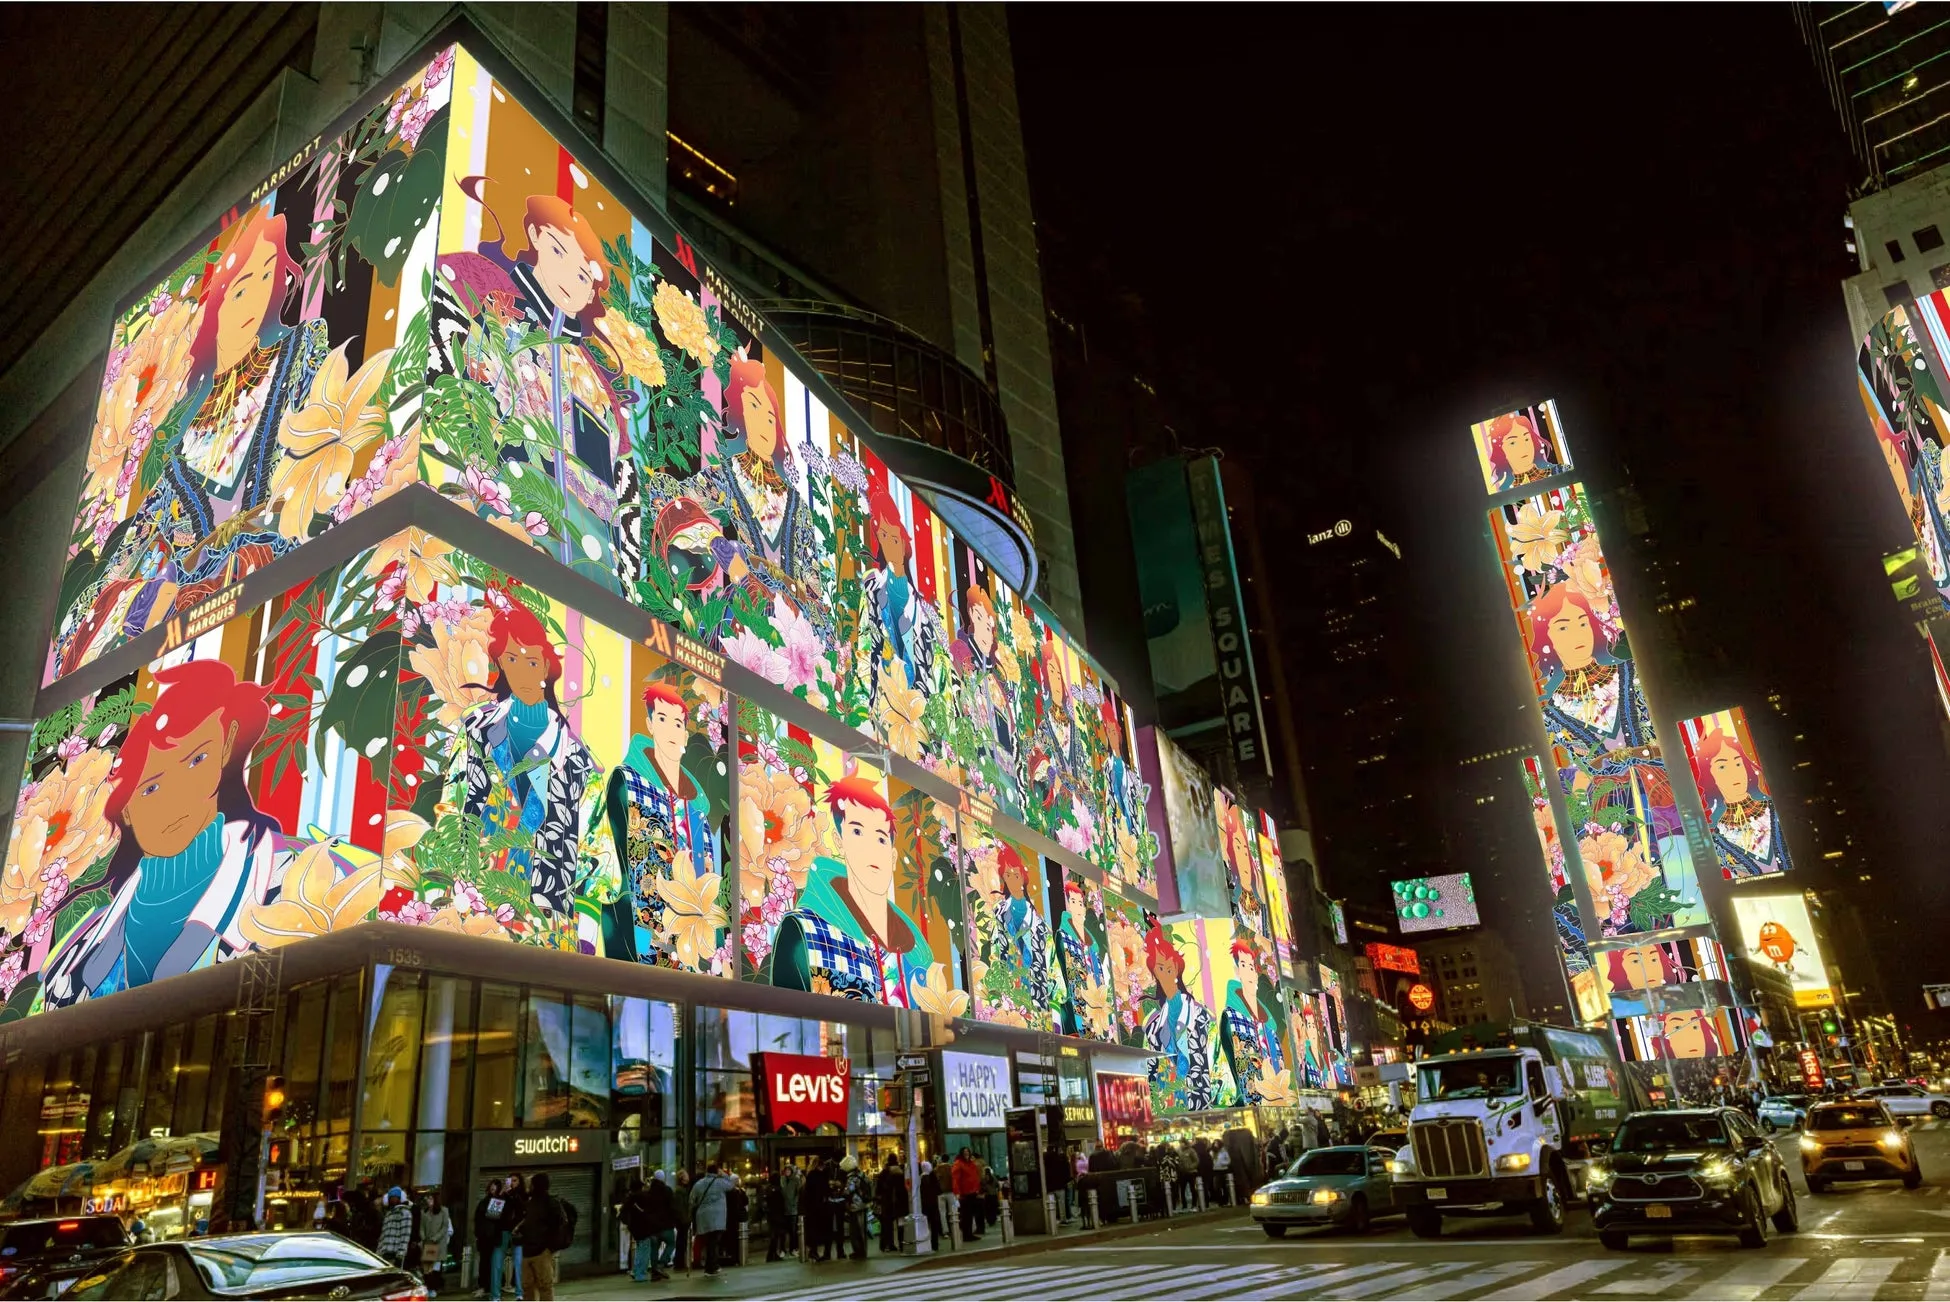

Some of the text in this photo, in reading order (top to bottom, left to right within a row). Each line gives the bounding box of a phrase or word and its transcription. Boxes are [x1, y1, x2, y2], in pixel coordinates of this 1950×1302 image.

[250, 136, 322, 204] MARRIOTT
[705, 265, 765, 332] MARRIOTT
[188, 583, 244, 622] MARRIOTT
[186, 603, 235, 637] MARQUIS
[676, 633, 726, 669] MARRIOTT
[676, 647, 721, 680] MARQUIS
[1214, 606, 1256, 761] SQUARE
[958, 1062, 997, 1090] HAPPY
[950, 1091, 1009, 1118] HOLIDAYS
[514, 1135, 568, 1154] swatch
[86, 1197, 121, 1214] SODA
